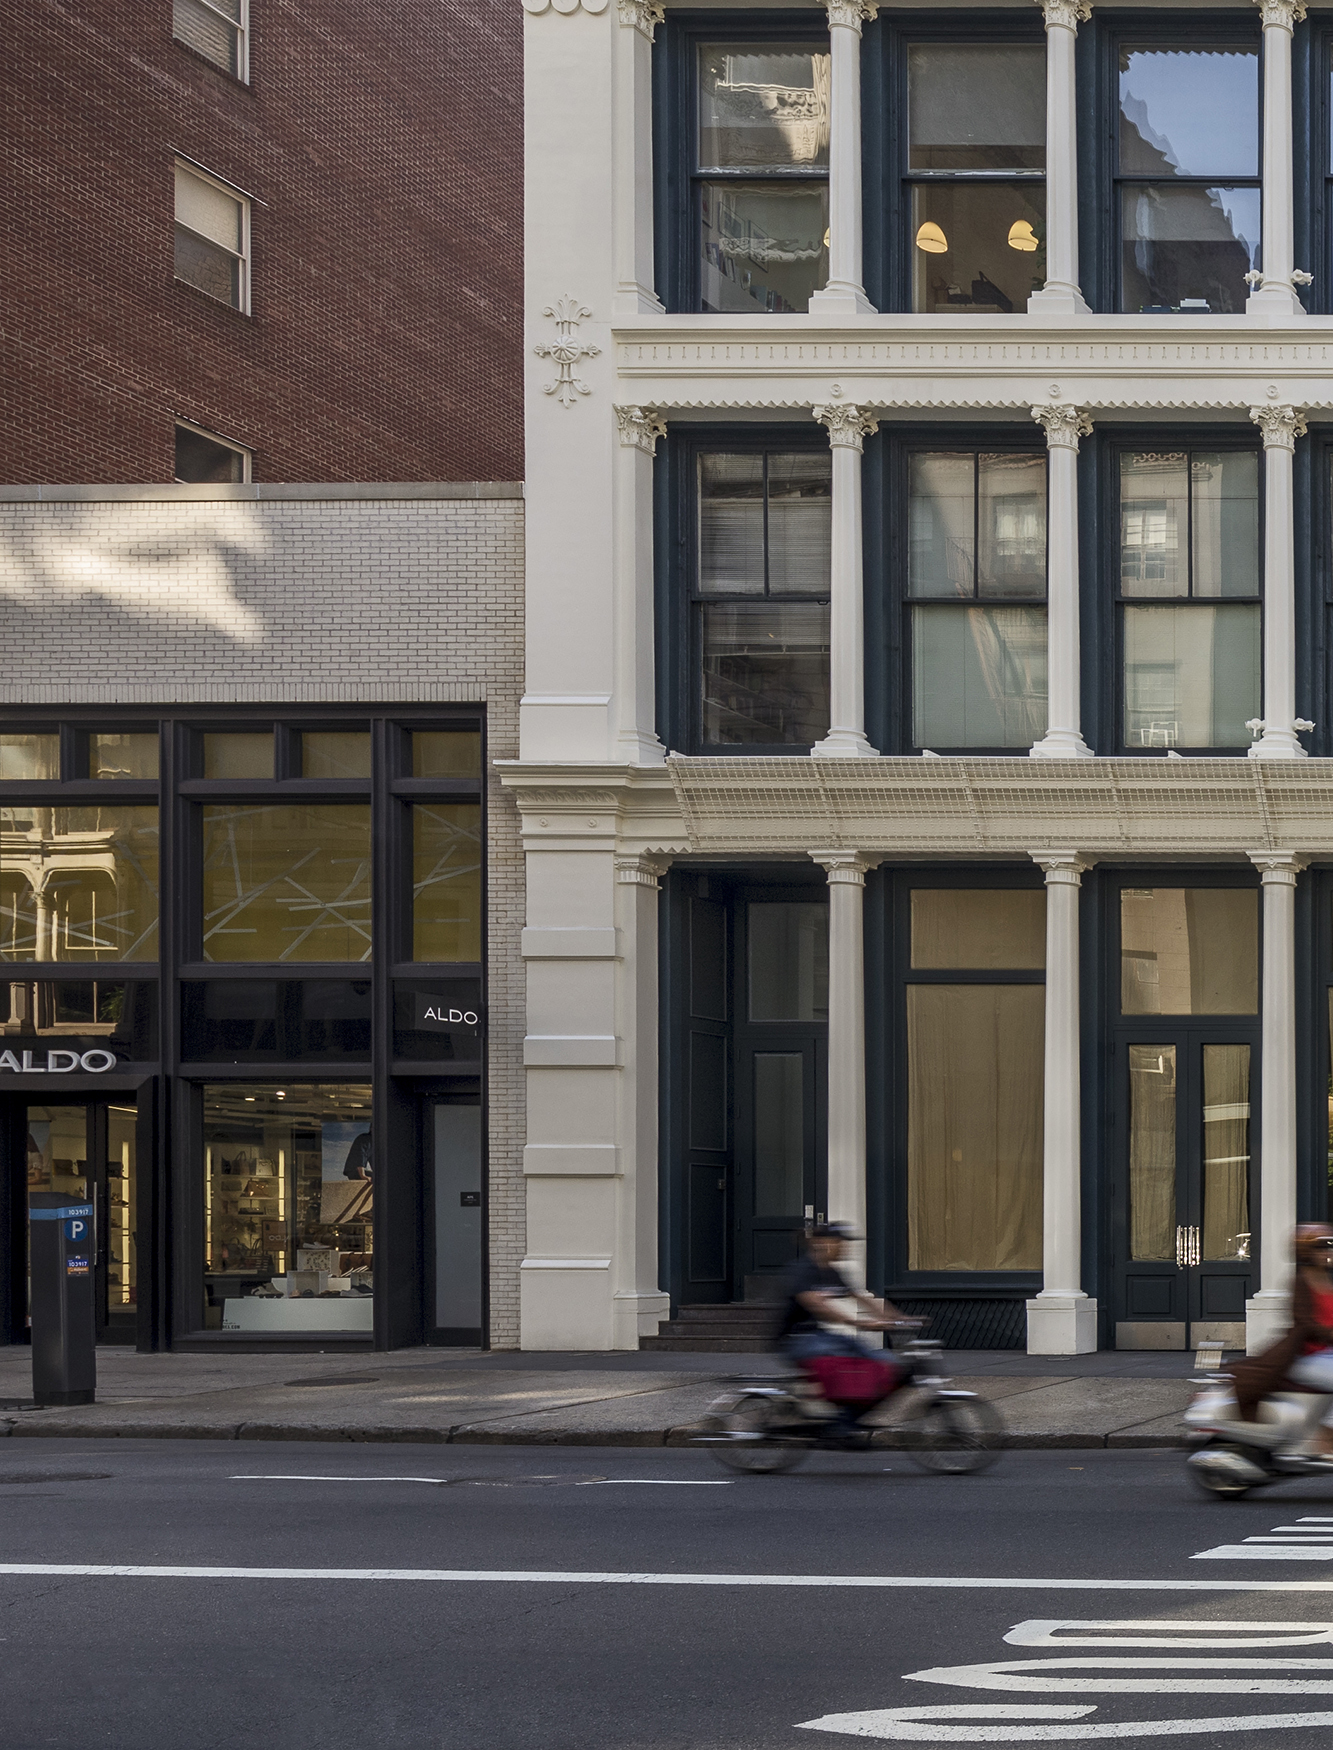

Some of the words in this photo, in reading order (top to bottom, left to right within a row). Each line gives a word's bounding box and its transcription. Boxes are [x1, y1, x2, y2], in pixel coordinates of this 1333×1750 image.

[424, 1006, 478, 1025] ALDO
[0, 1050, 116, 1072] ALDO
[72, 1221, 84, 1238] P
